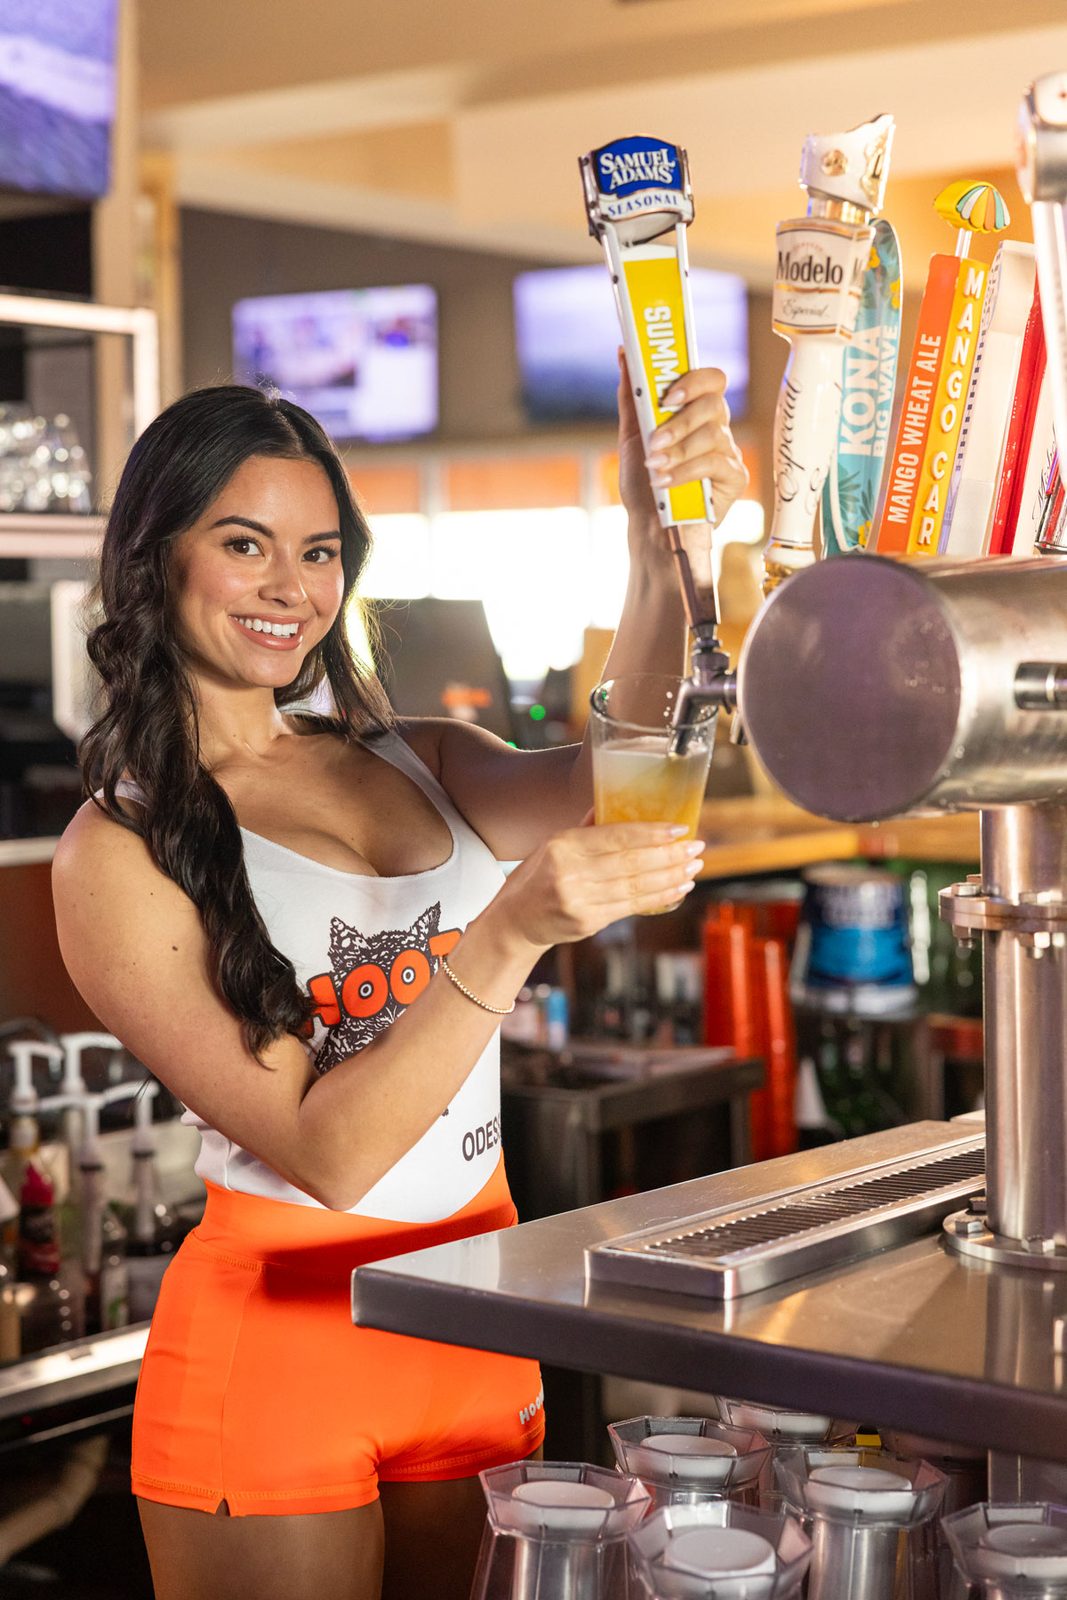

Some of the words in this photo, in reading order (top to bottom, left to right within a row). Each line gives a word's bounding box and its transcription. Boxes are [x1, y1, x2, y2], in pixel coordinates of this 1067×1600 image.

[600, 149, 676, 174] SAMUEL
[609, 165, 673, 190] ADAMS
[608, 195, 678, 216] SEASONAL
[776, 251, 843, 284] Modelo
[877, 325, 898, 404] WAVE
[916, 333, 942, 373] ALE
[939, 267, 985, 434] MANGO
[839, 326, 880, 457] KONA
[901, 378, 935, 447] WHEAT
[873, 409, 889, 457] BIG
[887, 452, 919, 525] MANGO
[914, 451, 949, 556] CAR
